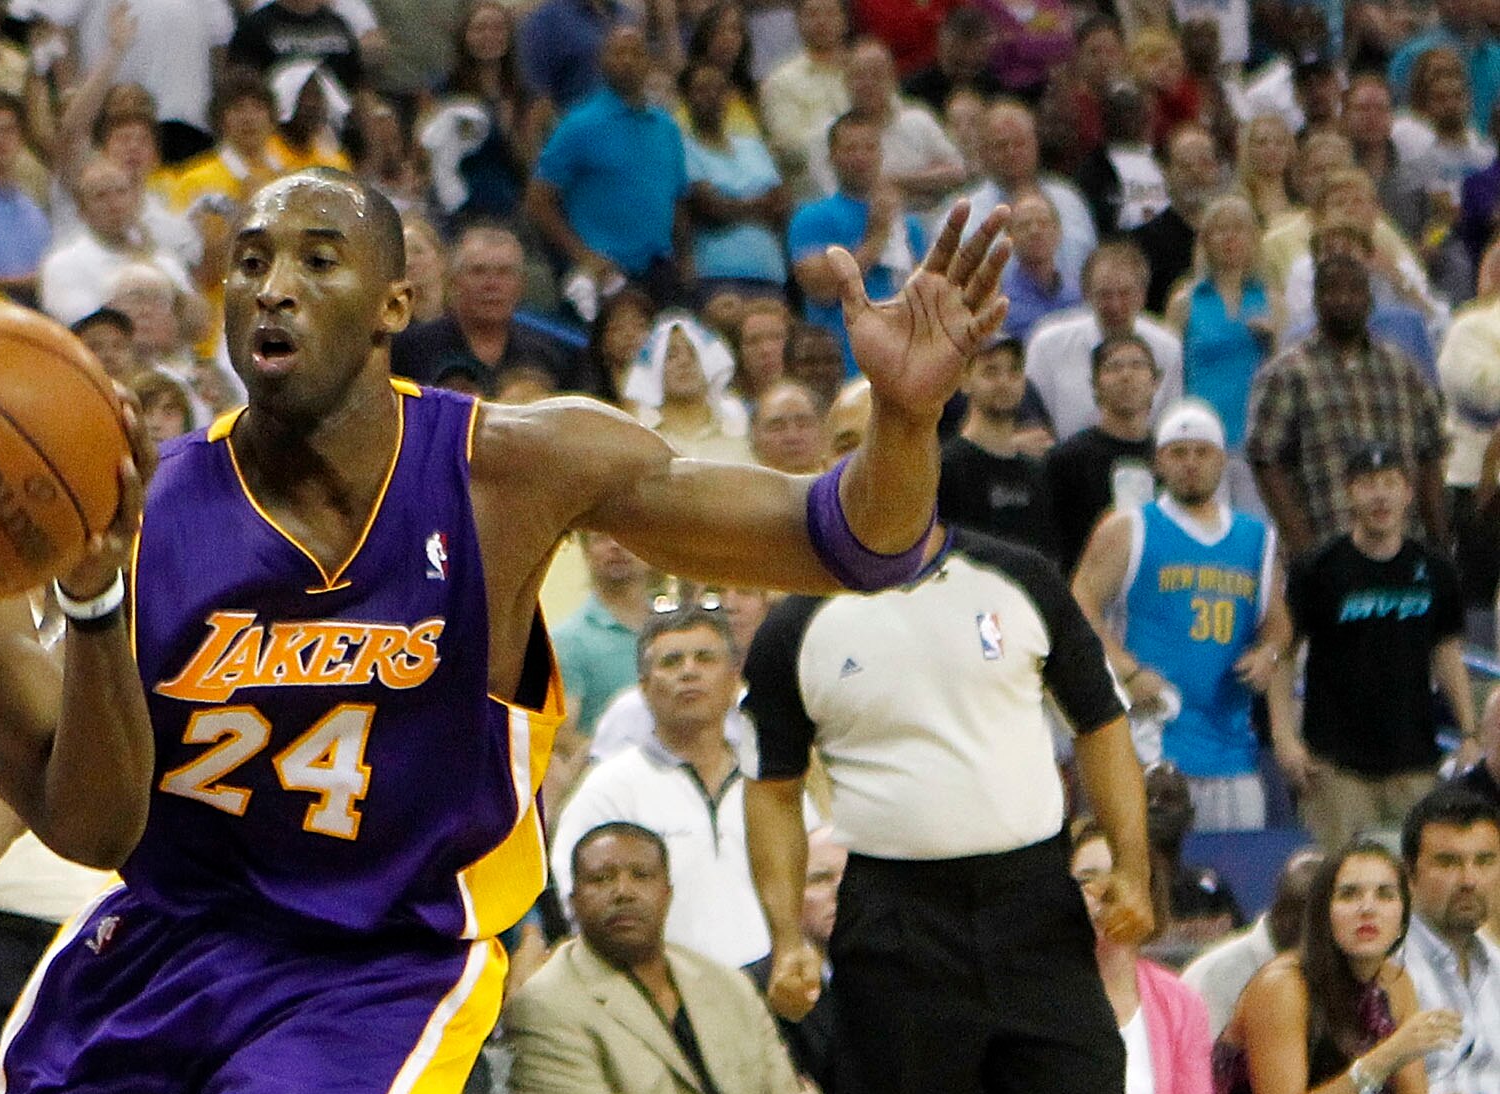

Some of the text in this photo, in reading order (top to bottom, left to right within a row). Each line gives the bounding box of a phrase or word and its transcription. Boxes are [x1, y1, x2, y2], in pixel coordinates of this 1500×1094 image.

[152, 609, 445, 703] LAKERS
[1190, 598, 1235, 645] 30
[158, 703, 377, 841] 24
